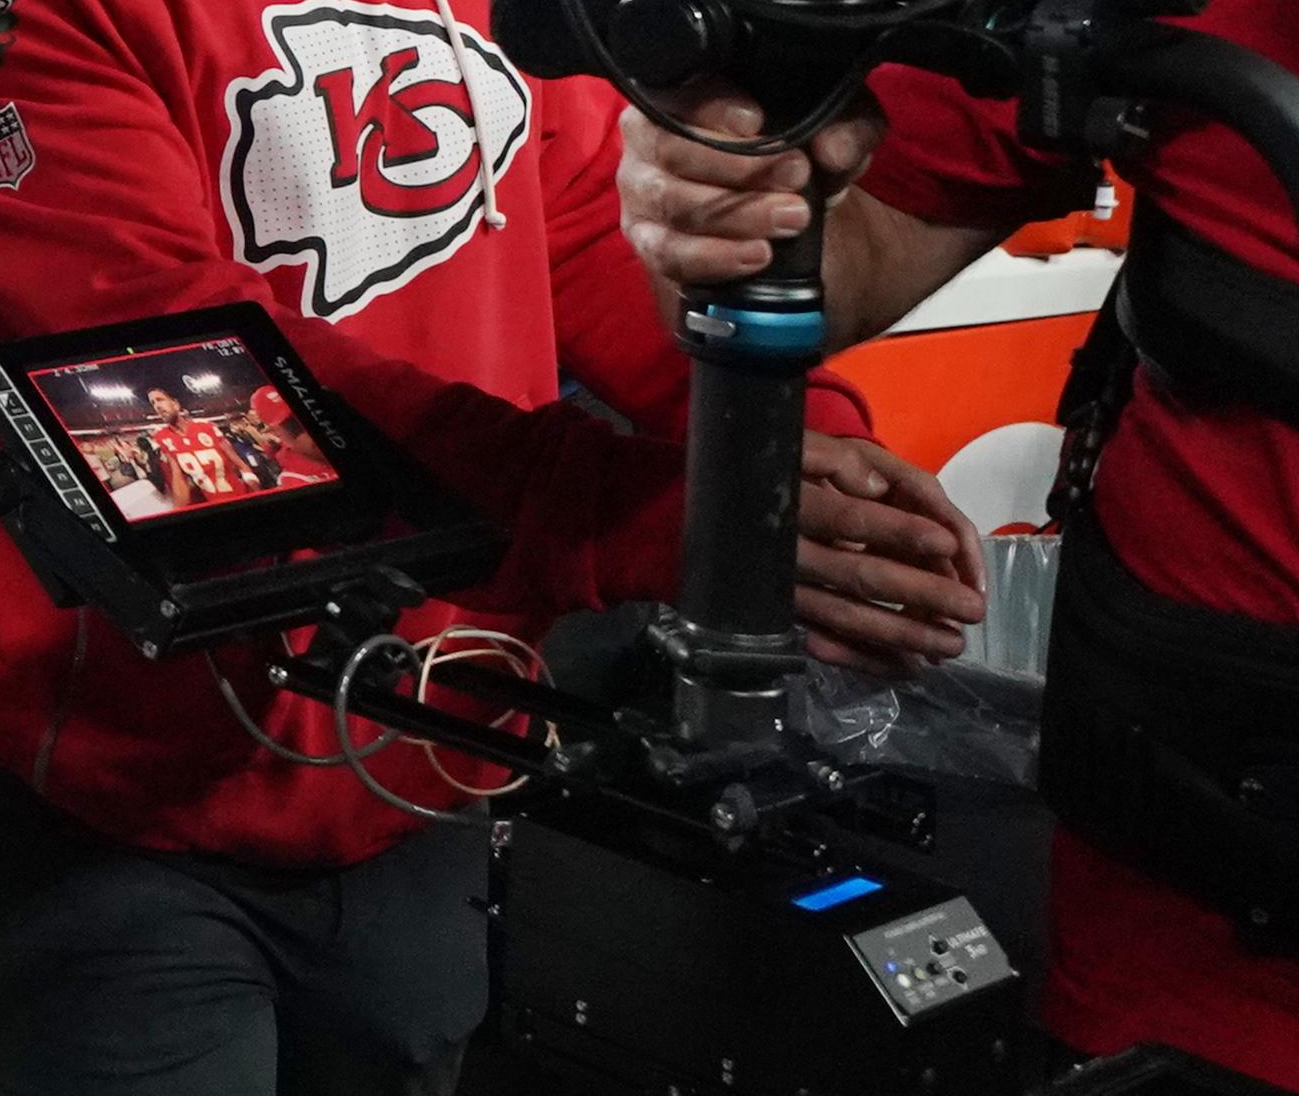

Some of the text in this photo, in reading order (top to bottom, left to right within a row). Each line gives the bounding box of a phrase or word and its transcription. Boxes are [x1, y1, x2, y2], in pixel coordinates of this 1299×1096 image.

[313, 45, 483, 219] KC
[274, 355, 347, 450] SMALLHD
[176, 448, 234, 493] 87
